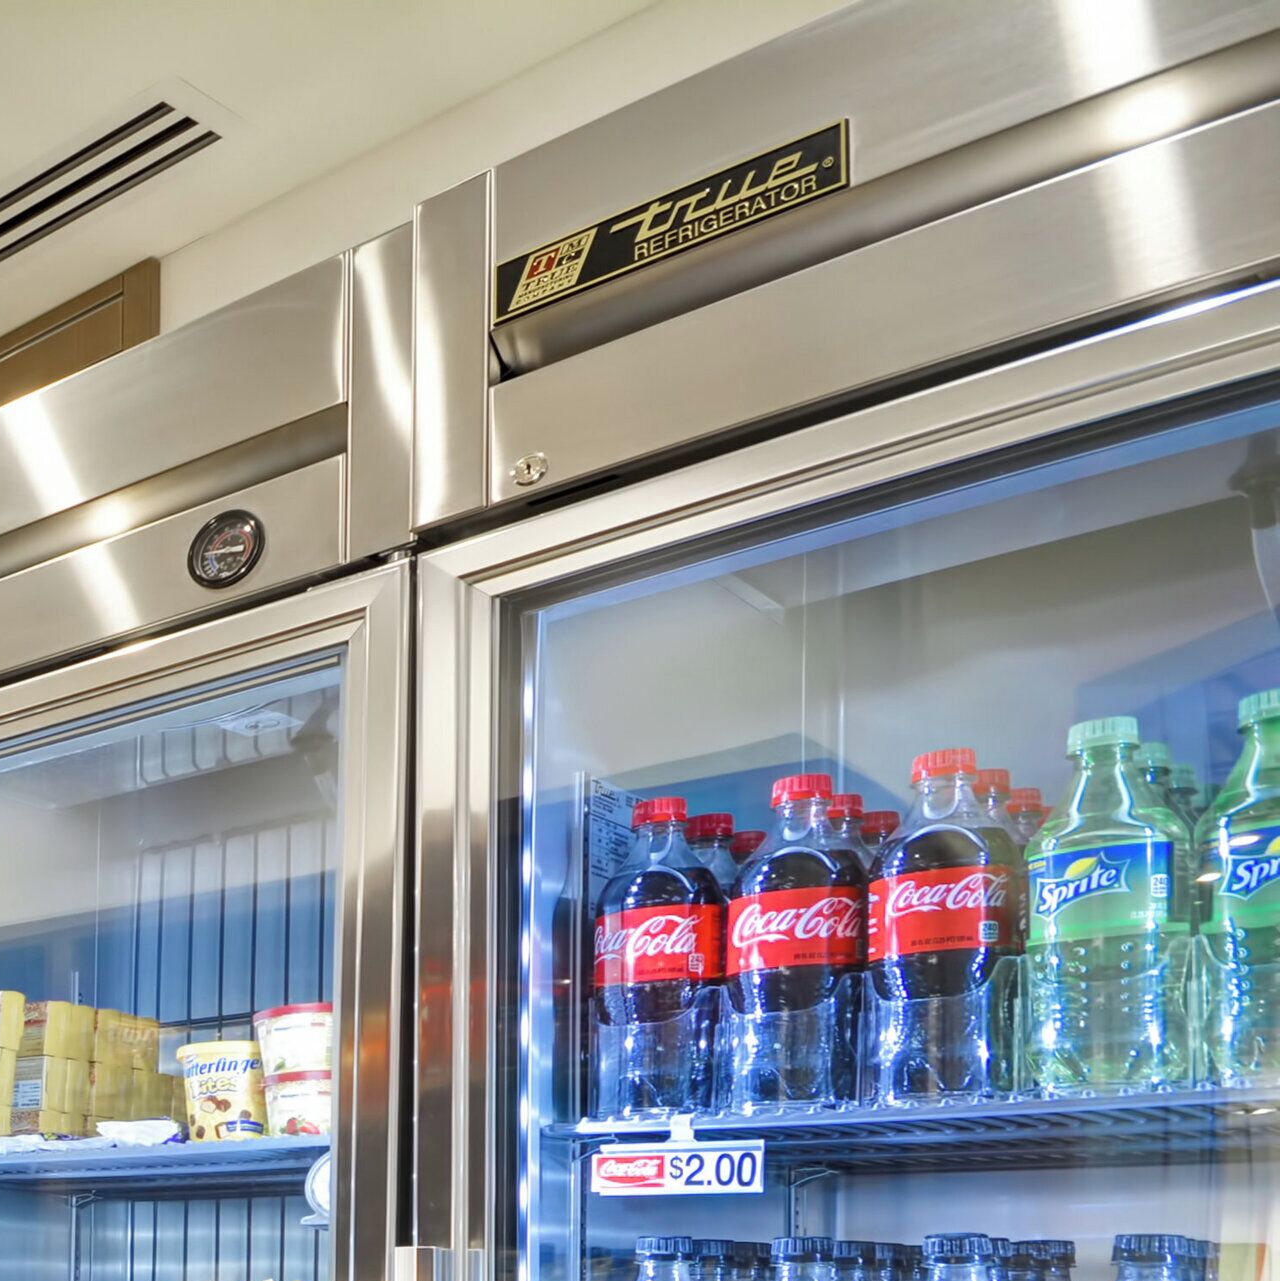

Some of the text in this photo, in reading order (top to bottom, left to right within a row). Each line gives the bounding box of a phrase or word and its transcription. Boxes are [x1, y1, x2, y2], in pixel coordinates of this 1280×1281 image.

[634, 175, 818, 262] REFRIGERATOR
[888, 872, 1009, 917] Coca-Cola
[1039, 866, 1118, 912] Sprite
[1231, 860, 1280, 892] Spr
[732, 896, 864, 949] Coca-Cola
[669, 1152, 757, 1187] $2.00
